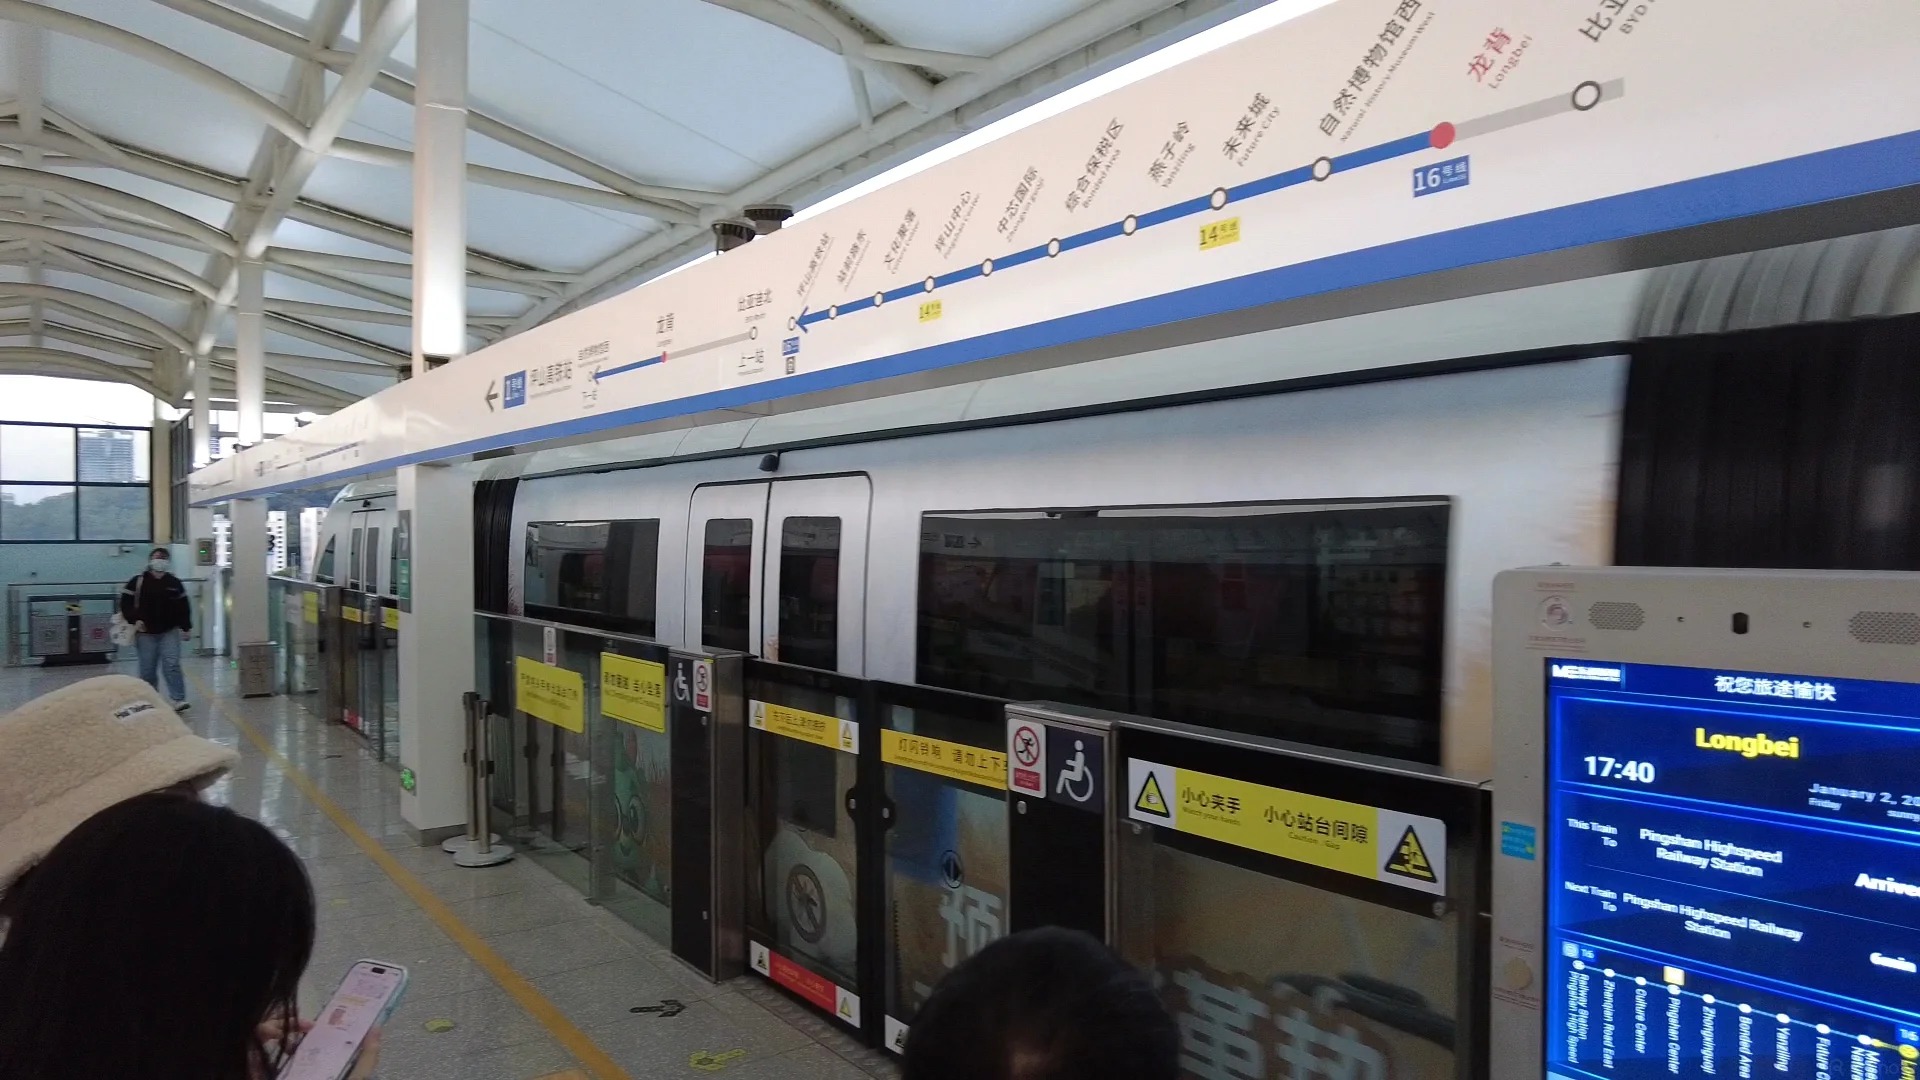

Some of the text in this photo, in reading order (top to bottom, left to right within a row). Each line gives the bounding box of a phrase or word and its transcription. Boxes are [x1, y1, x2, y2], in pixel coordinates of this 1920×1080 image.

[1619, 4, 1648, 34] BYD
[1319, 0, 1422, 137] 自然博物馆西
[1467, 27, 1512, 83] 龙背
[1488, 34, 1533, 89] Longbei
[1222, 92, 1270, 160] 未来城
[1065, 117, 1124, 213] 综合保税区
[1148, 121, 1191, 183] 燕子岭
[1714, 675, 1838, 701] 祝您旅途愉快
[1695, 727, 1799, 759] Longbei
[1584, 755, 1656, 784] 17:40
[1182, 786, 1242, 815] 小心夹手
[1808, 782, 1876, 803] January
[1880, 792, 1898, 805] 2,
[1263, 805, 1368, 845] 小心站台间隙
[1566, 818, 1618, 836] This Train
[1601, 836, 1618, 847] To
[1639, 828, 1784, 865] Pingshan Highspeed
[1656, 847, 1764, 878] Railway Station
[1564, 880, 1618, 901] Next Train
[1601, 901, 1618, 912] To
[1622, 892, 1804, 942] Pingshan Highspeed Railway
[1684, 920, 1732, 940] Station
[1634, 988, 1648, 1054] Culture Center
[1666, 997, 1681, 1074] Pingshan Center
[1738, 1016, 1753, 1079] Bonded Area
[1774, 1027, 1792, 1072] Yanziling
[1815, 1036, 1831, 1070] Future
